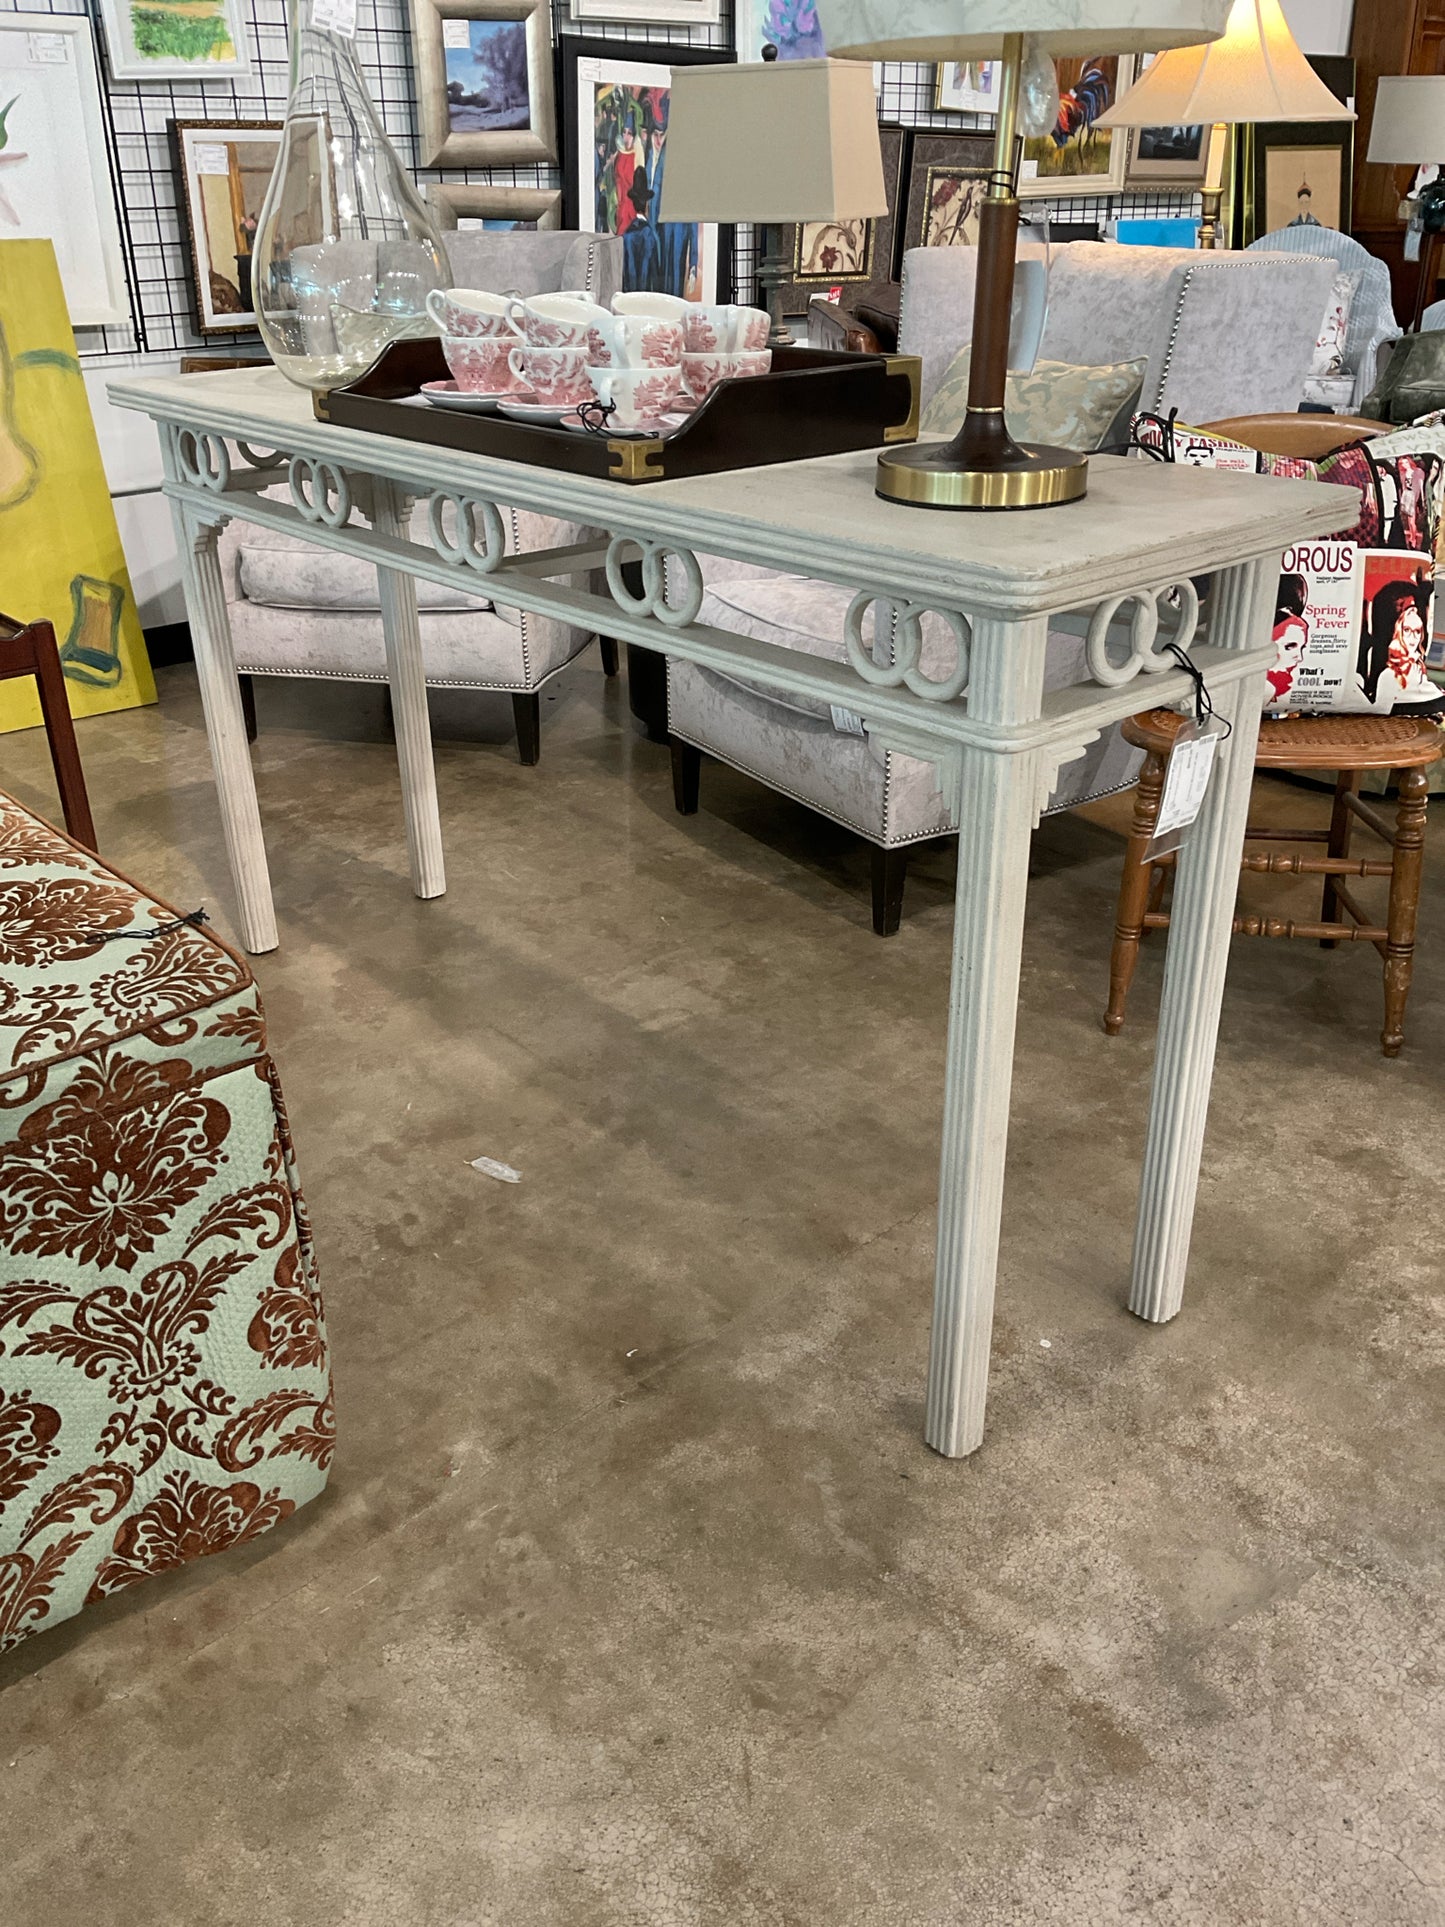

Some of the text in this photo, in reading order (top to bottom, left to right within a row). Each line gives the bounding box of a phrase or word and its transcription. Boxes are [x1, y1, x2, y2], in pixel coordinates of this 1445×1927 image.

[1305, 604, 1347, 618] Spring
[1316, 618, 1350, 629] Fever
[1297, 677, 1320, 686] COOL
